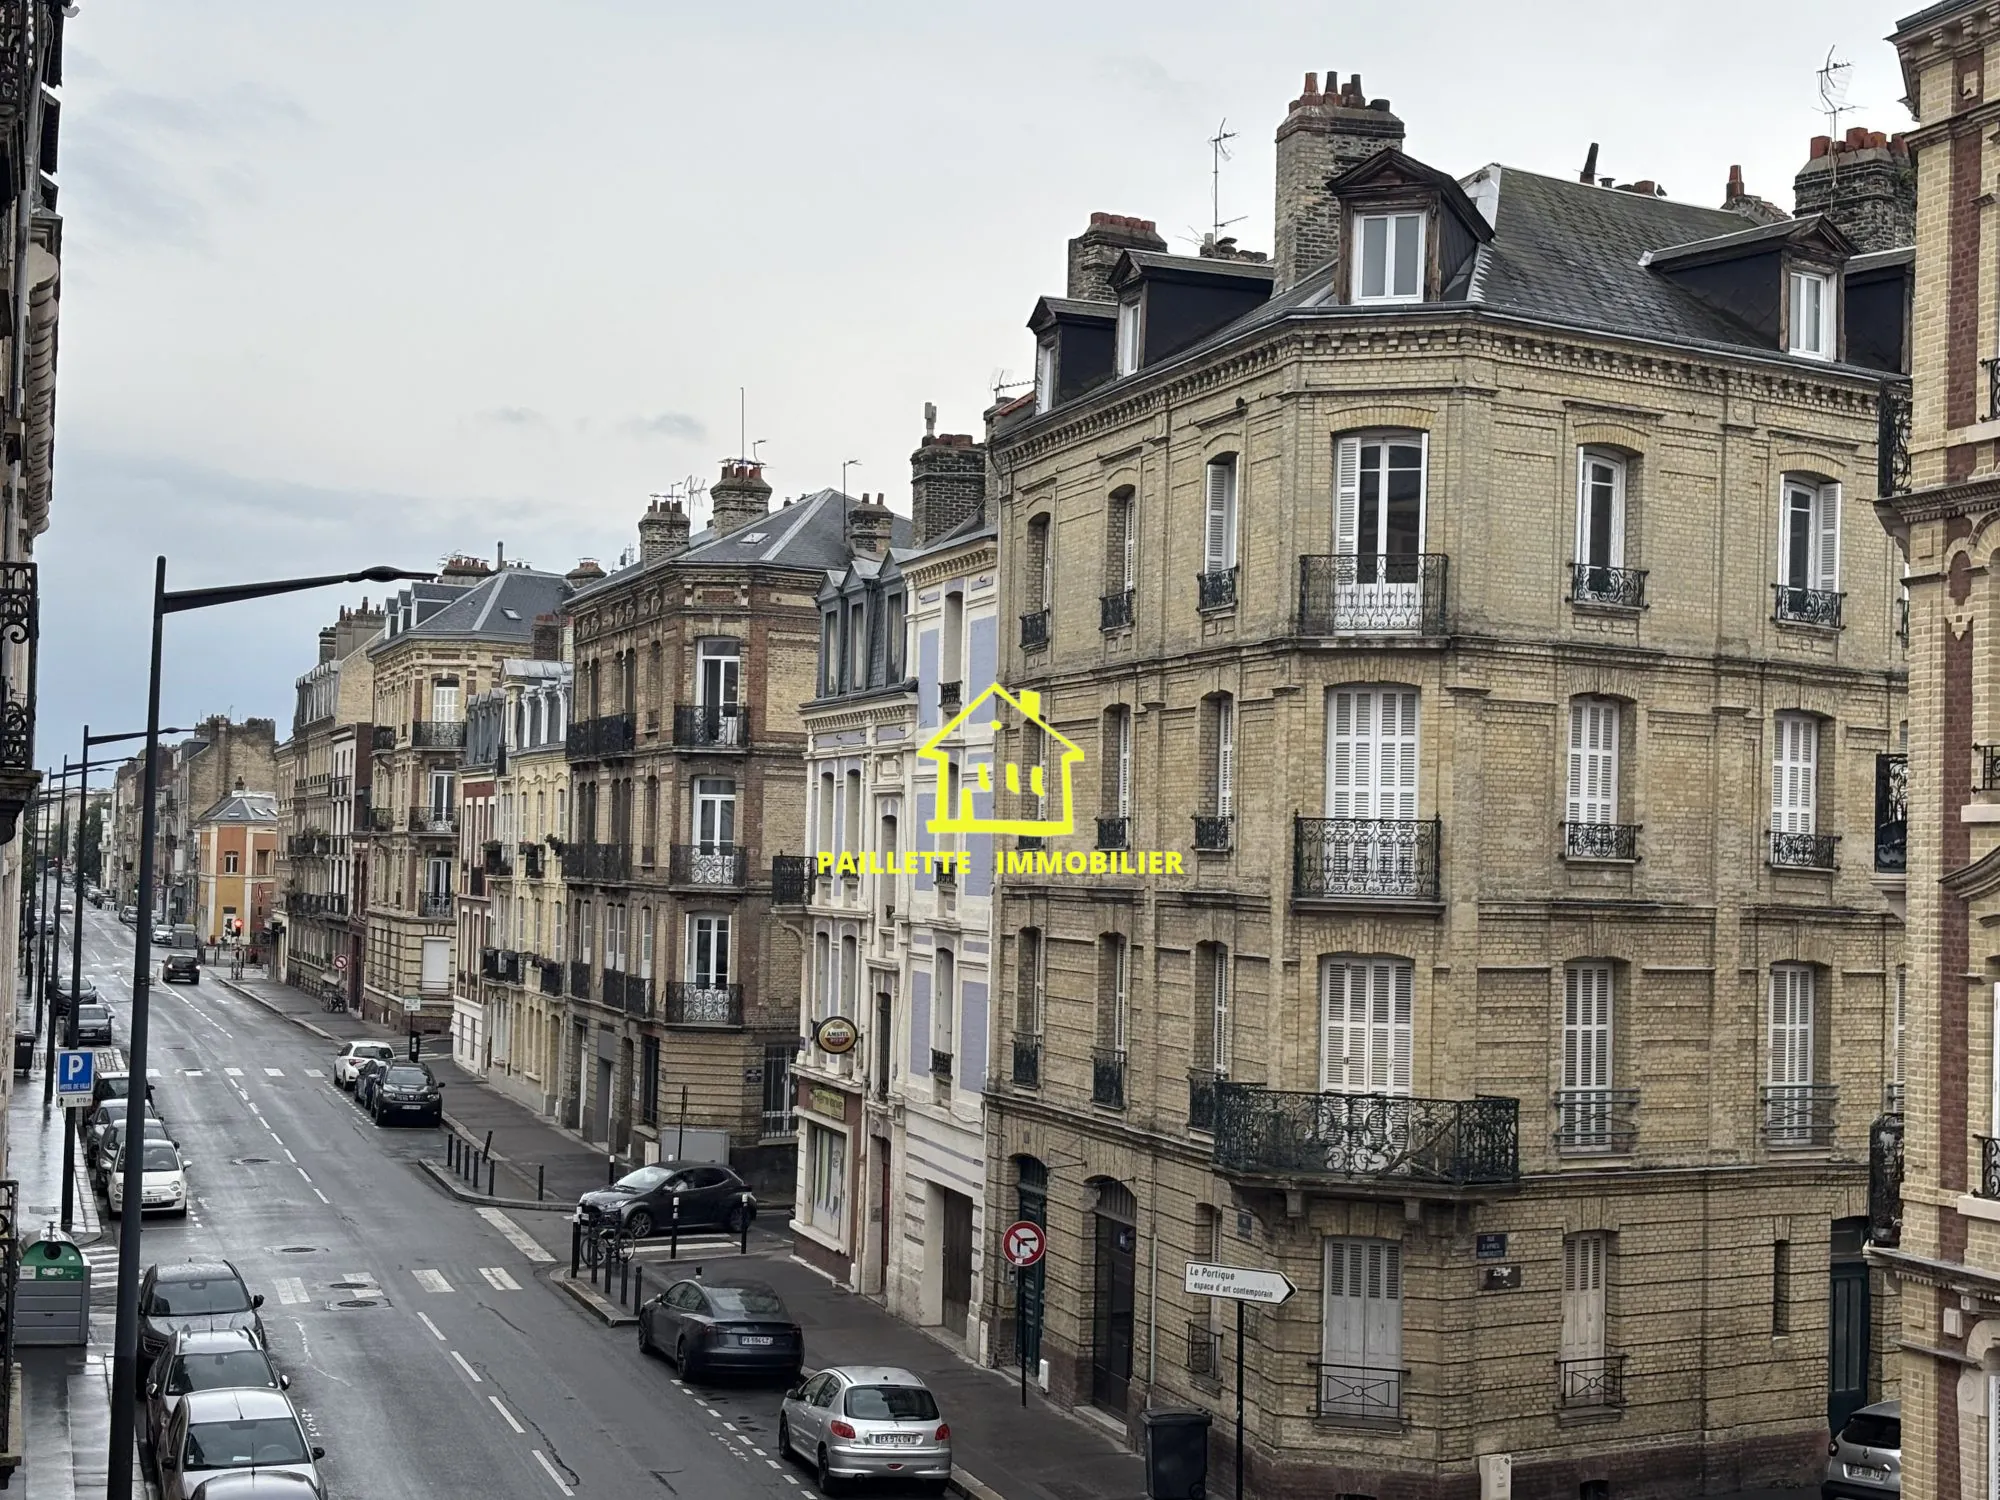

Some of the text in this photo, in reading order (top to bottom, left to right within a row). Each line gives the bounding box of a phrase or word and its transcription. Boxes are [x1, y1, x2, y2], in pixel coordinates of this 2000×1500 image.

[68, 1055, 83, 1080] P
[1190, 1266, 1235, 1281] Le Portique
[1193, 1282, 1214, 1291] espace
[1233, 1286, 1273, 1299] contemporain
